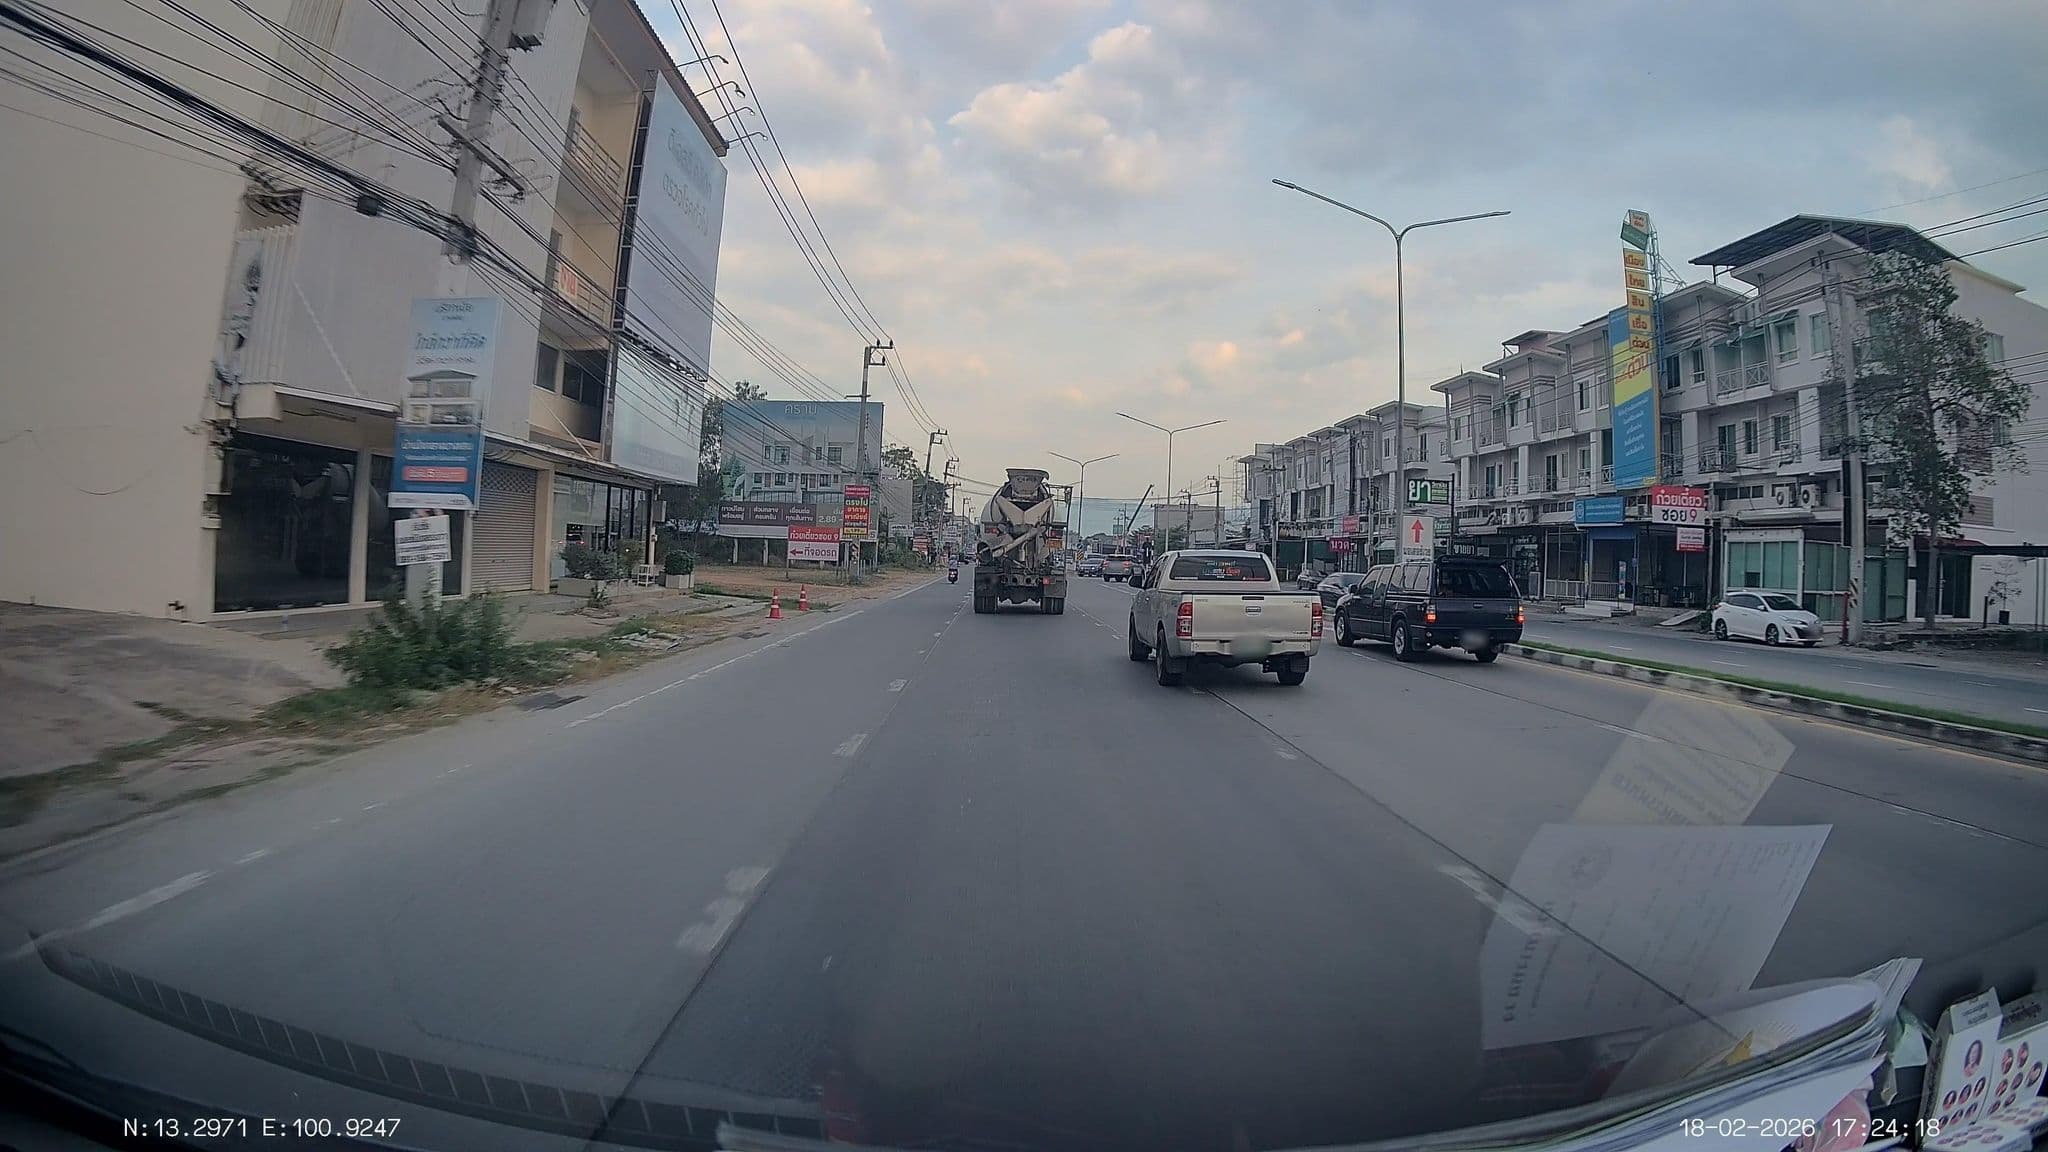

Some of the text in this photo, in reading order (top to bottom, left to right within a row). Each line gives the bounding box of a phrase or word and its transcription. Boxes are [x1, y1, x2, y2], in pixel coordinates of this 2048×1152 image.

[784, 403, 818, 415] คราม
[1408, 480, 1432, 502] ยา
[1655, 488, 1703, 507] ก๋วยเตี๋ยว
[845, 497, 869, 506] ตรงไป
[818, 515, 837, 523] 2.89
[1661, 508, 1698, 522] ซอย 9
[790, 528, 832, 541] ก๋วยเตี๋ยวซอย
[804, 543, 837, 557] ที่จอดรถ
[1330, 540, 1350, 551] นวด
